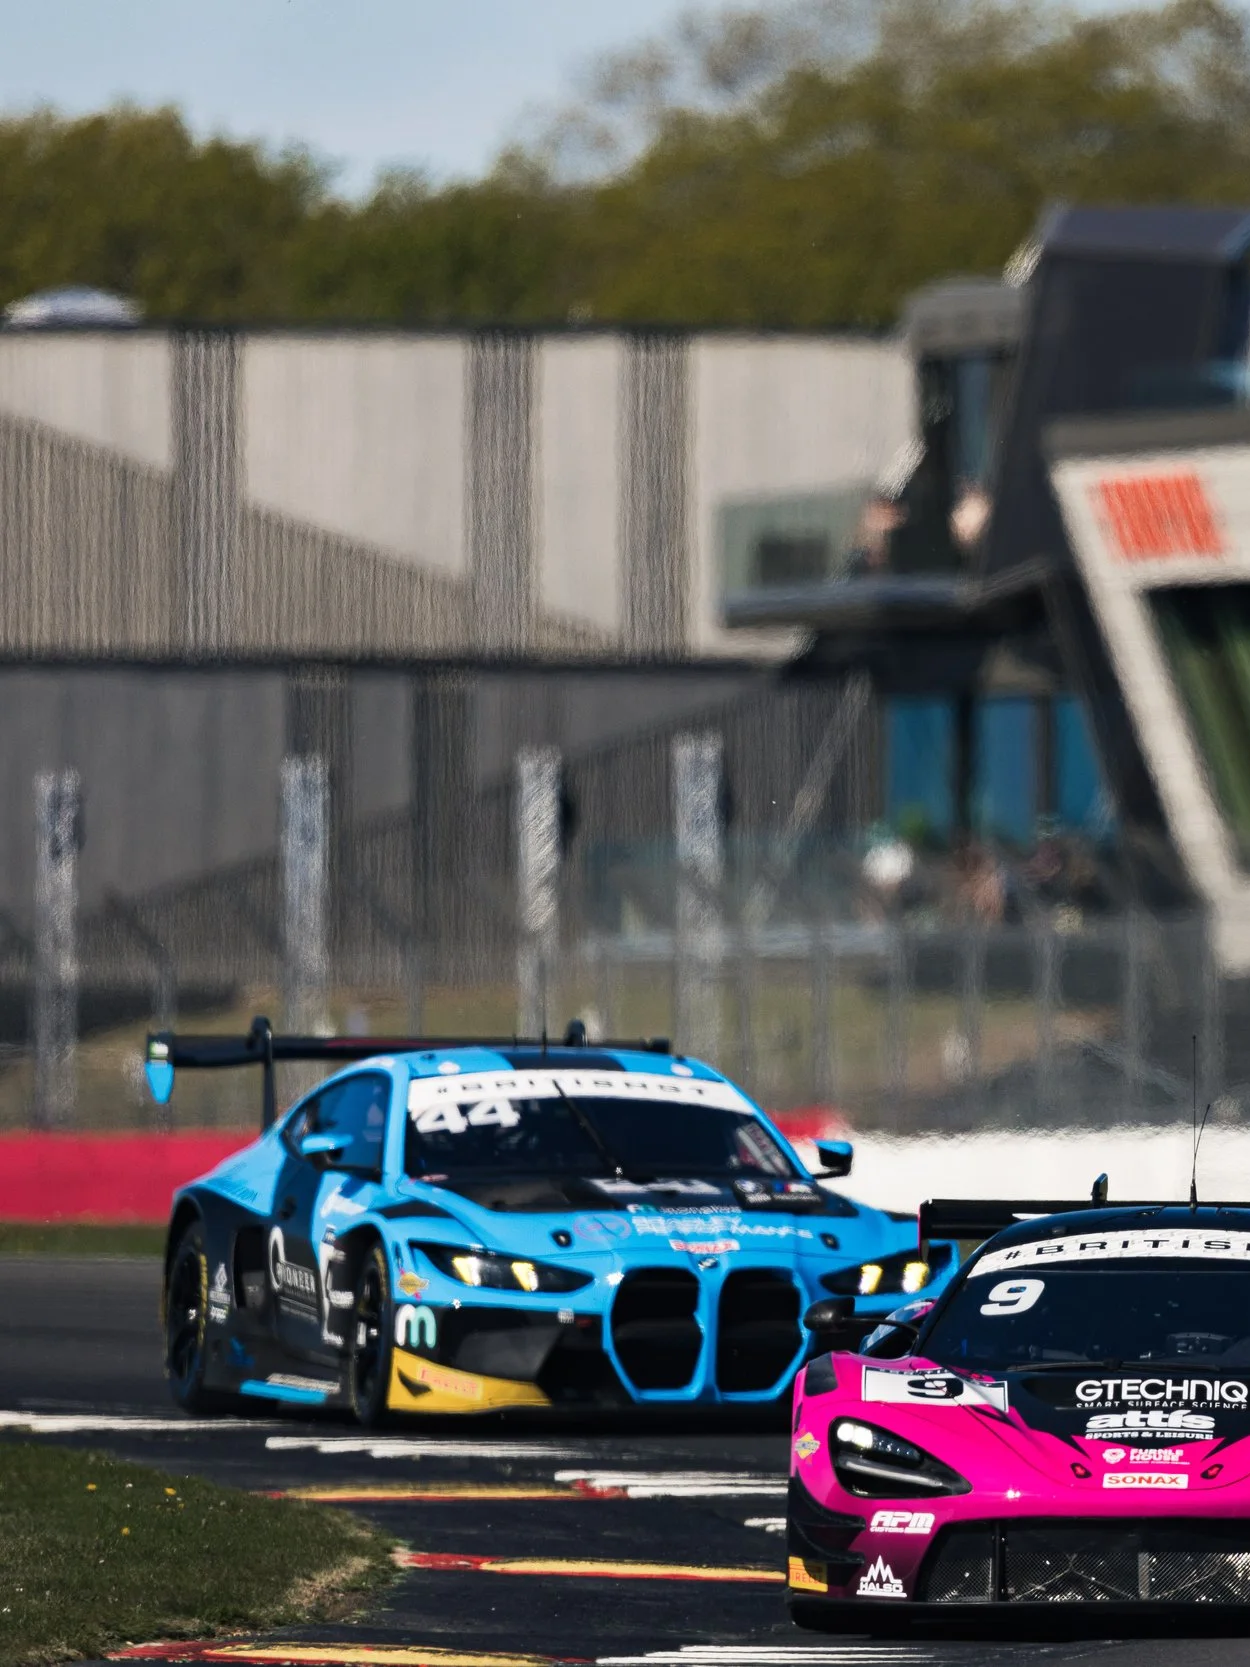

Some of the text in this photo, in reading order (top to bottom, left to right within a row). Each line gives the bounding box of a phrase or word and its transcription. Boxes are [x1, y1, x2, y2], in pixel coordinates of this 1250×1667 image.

[415, 1097, 522, 1135] 44
[980, 1278, 1046, 1316] 9
[908, 1377, 964, 1399] 9
[1075, 1379, 1249, 1403] GTECHNIQ
[1086, 1410, 1216, 1430] attis
[1107, 1476, 1180, 1485] SONAX
[859, 1582, 904, 1593] HALSO
